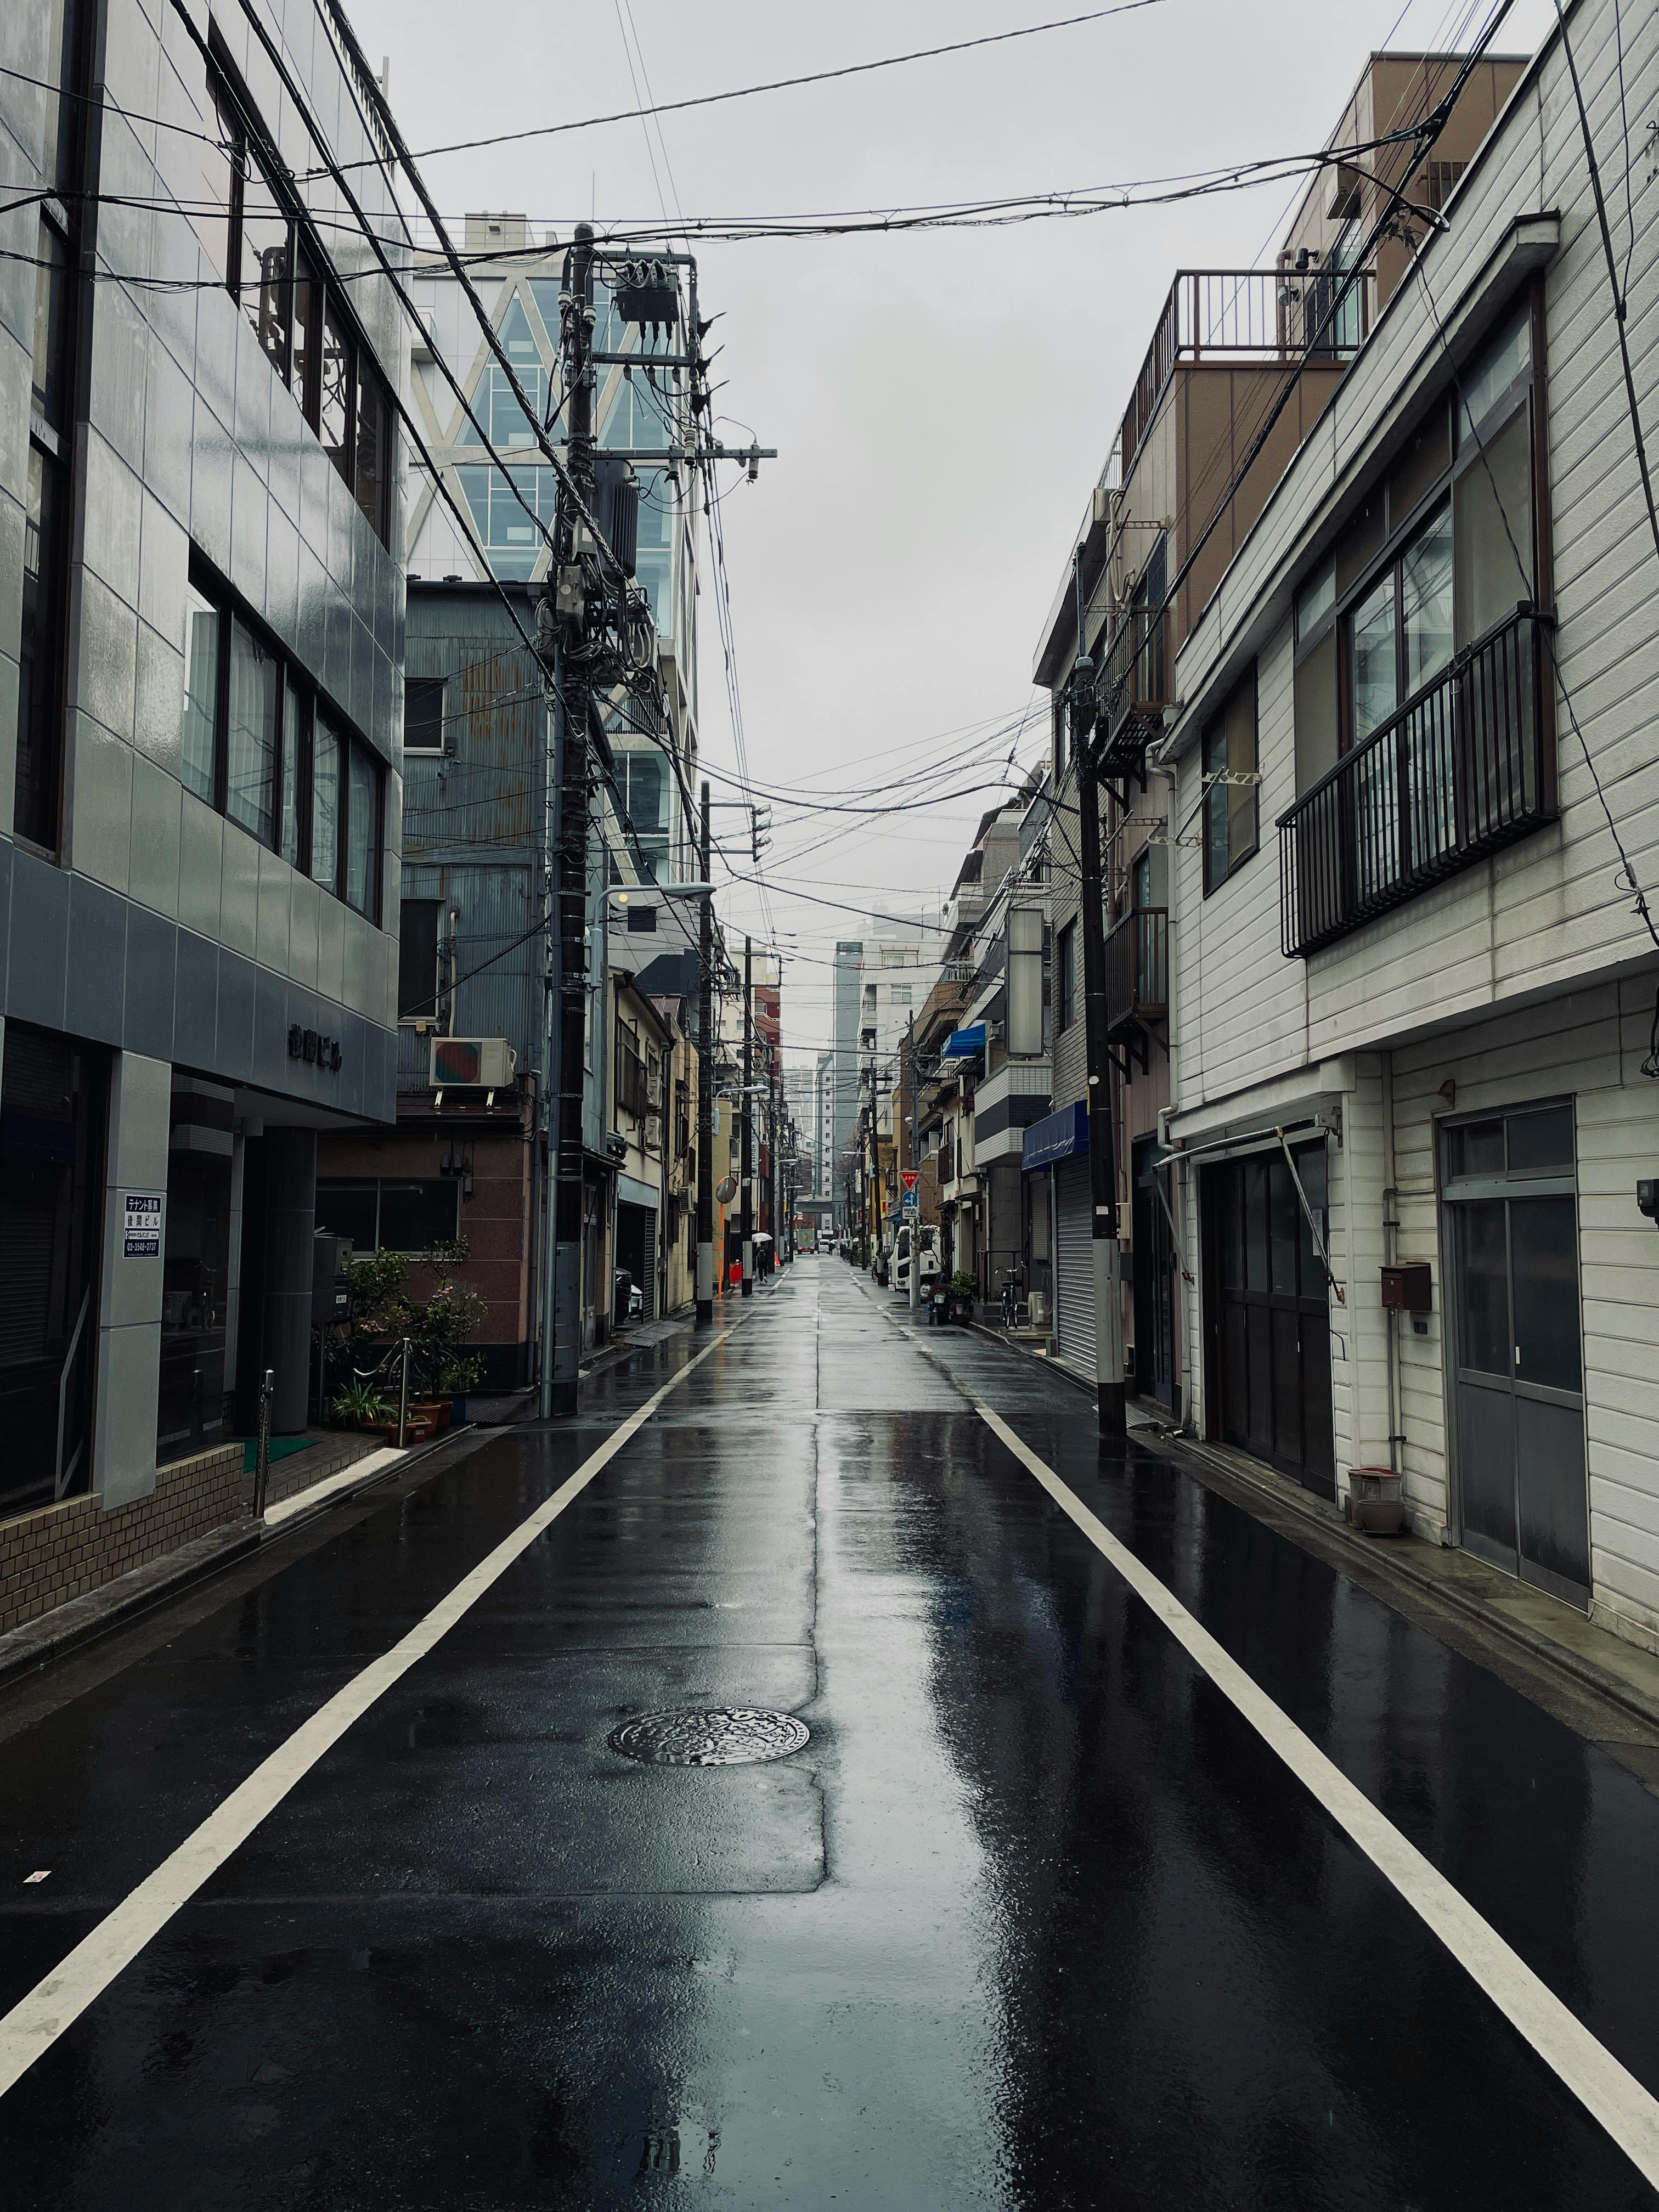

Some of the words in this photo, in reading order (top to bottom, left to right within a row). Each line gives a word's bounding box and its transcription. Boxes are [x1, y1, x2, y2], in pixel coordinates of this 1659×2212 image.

[128, 1199, 158, 1211] テナント募集
